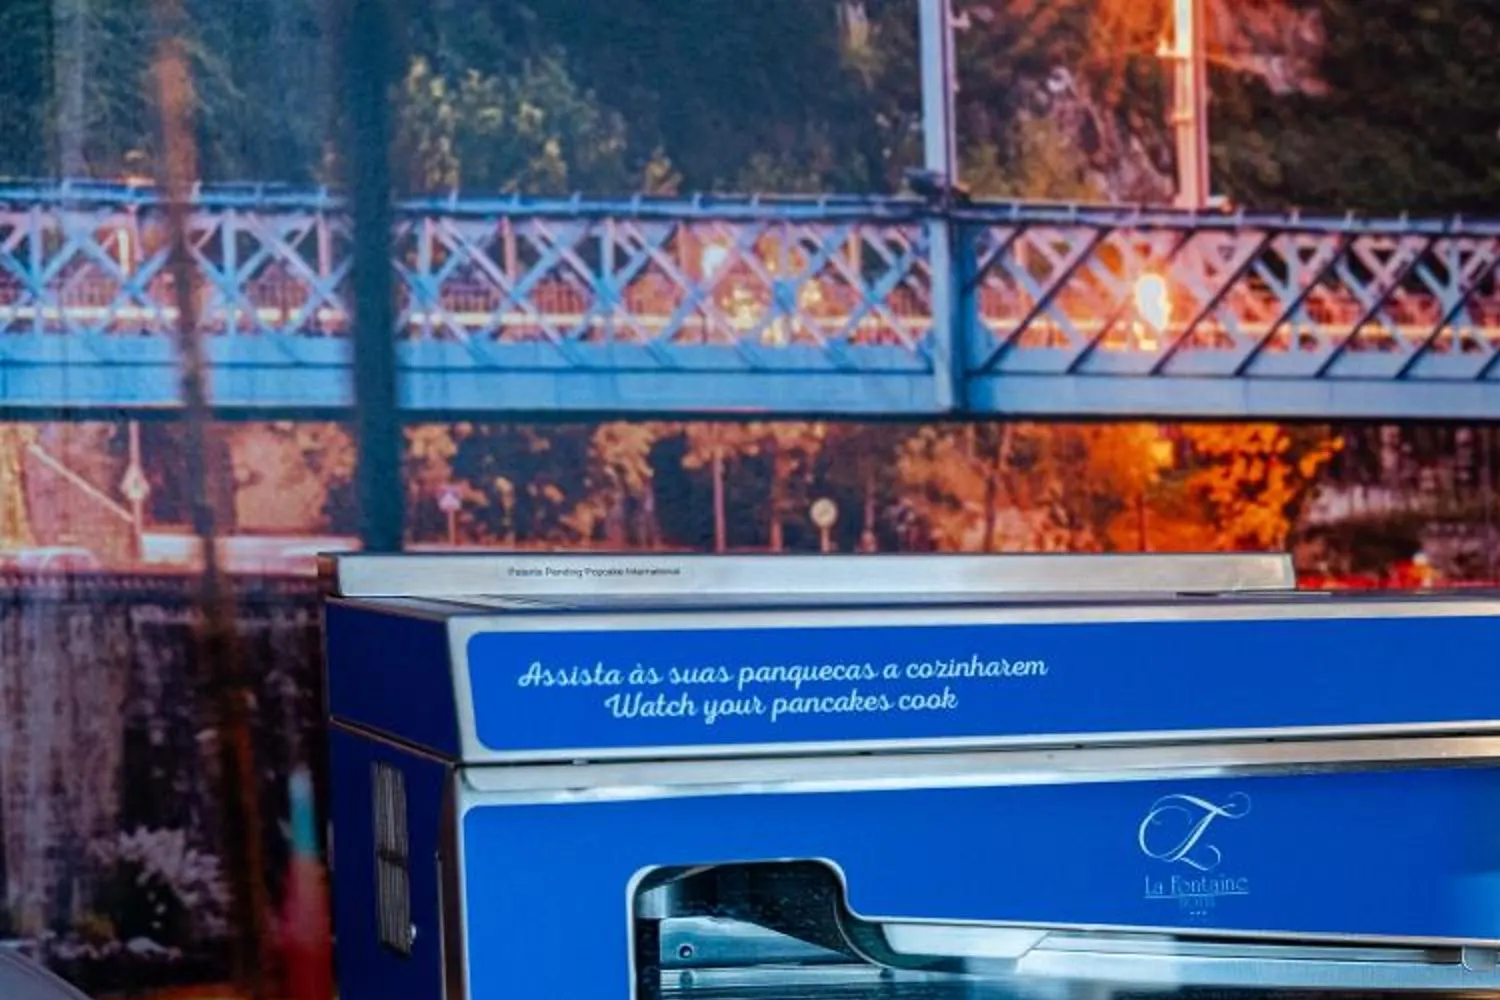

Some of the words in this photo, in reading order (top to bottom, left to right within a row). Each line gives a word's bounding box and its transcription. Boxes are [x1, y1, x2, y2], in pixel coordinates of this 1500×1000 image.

[518, 661, 623, 687] Assista
[628, 663, 663, 685] às
[668, 668, 733, 684] suas
[737, 662, 878, 690] panquecas
[883, 664, 901, 680] a
[905, 655, 1048, 680] cozinharem
[605, 693, 698, 718] Watch
[703, 697, 765, 724] your
[772, 689, 894, 721] pancakes
[898, 686, 958, 711] cook
